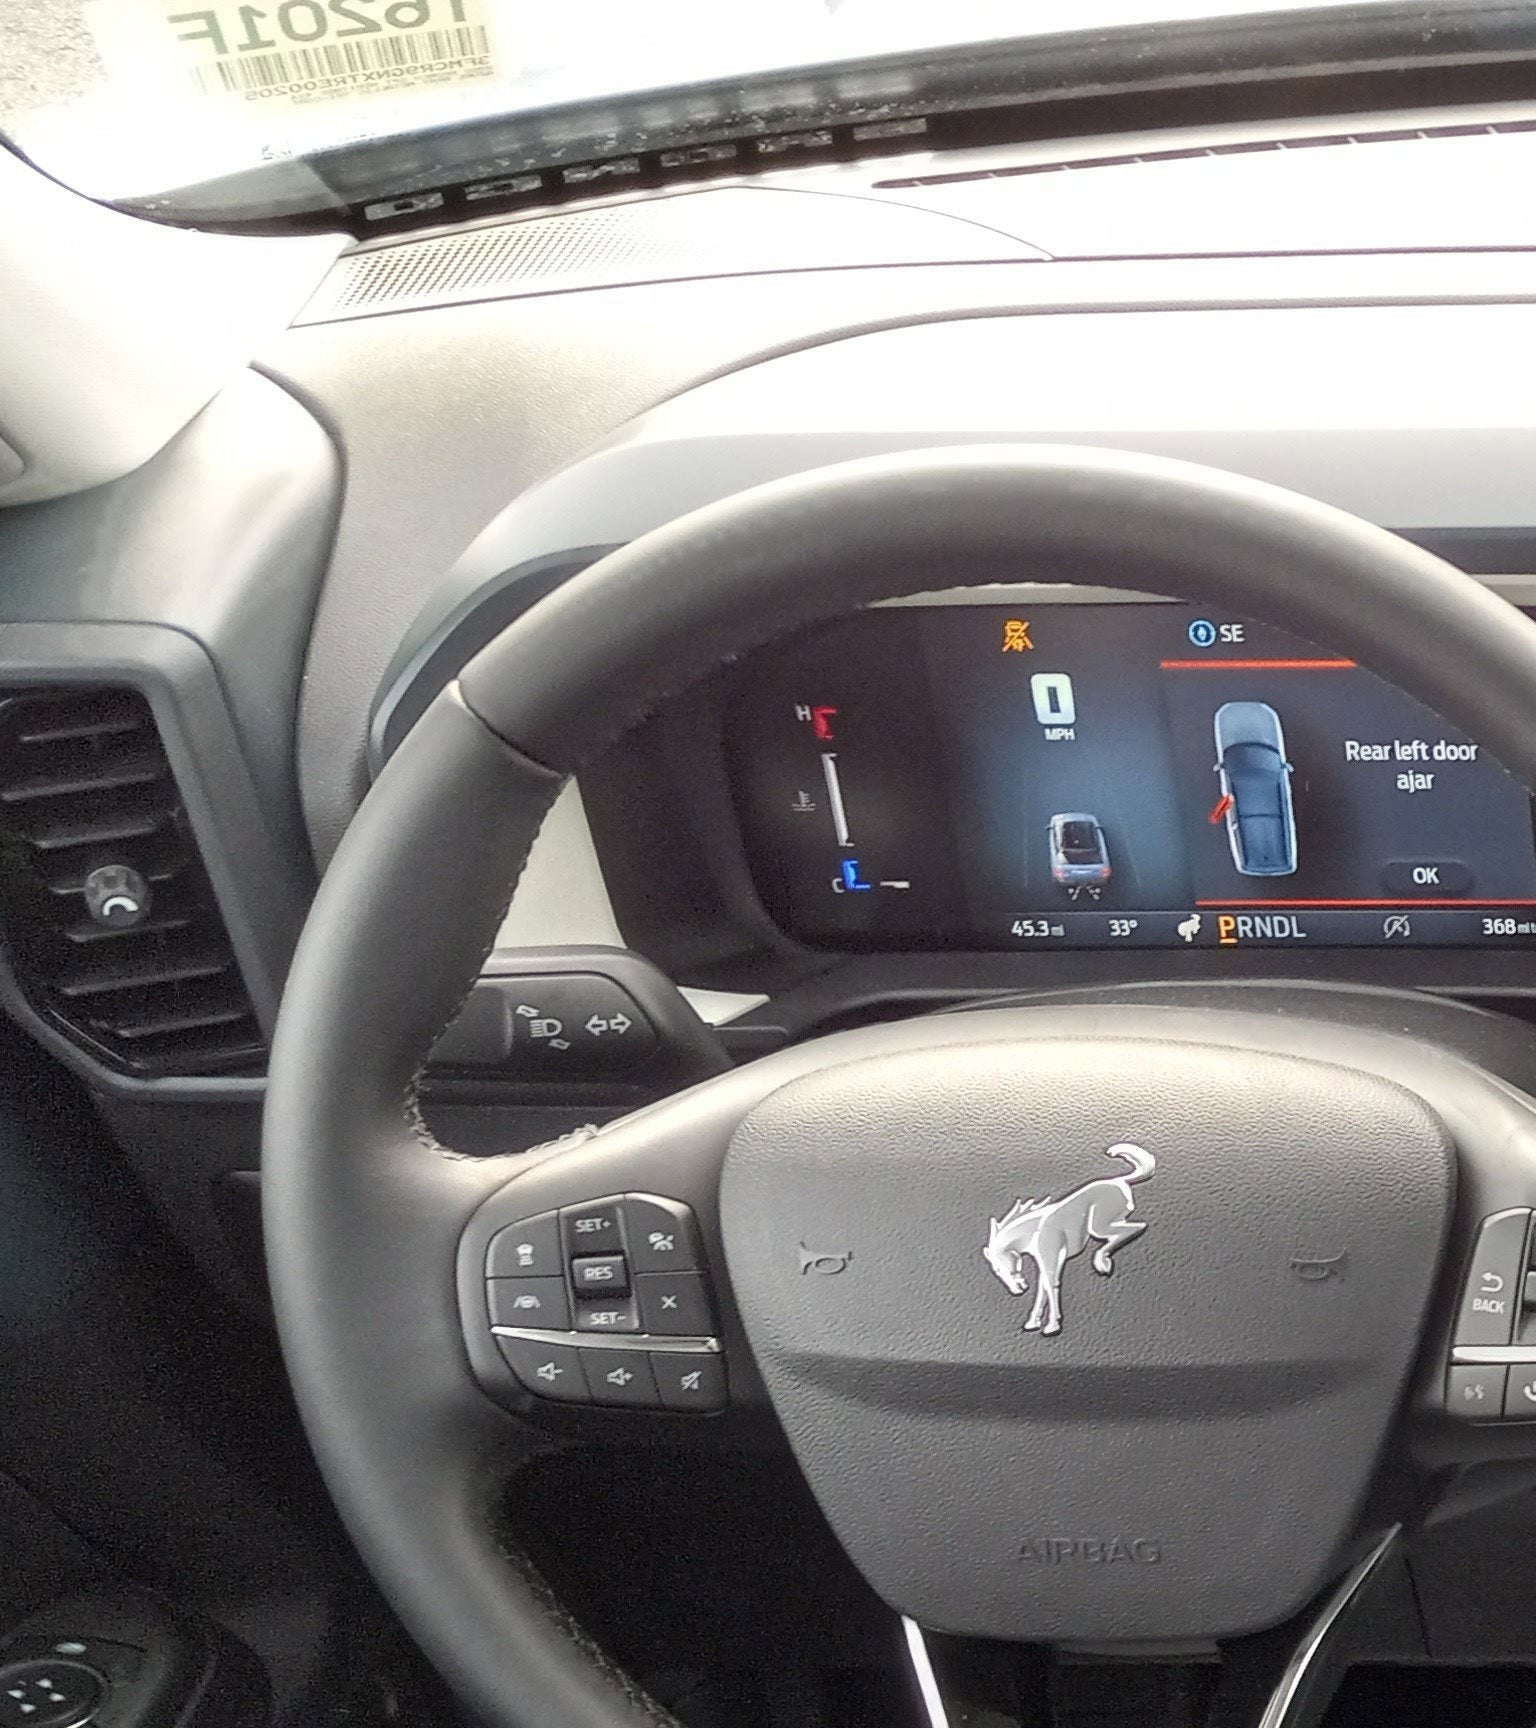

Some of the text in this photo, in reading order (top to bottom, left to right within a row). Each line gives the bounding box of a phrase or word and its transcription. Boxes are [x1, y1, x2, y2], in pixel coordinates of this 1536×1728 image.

[1220, 624, 1245, 643] SE
[1030, 672, 1076, 725] 0
[1044, 728, 1076, 742] MPH
[1344, 739, 1479, 761] Rear left door
[1396, 769, 1436, 793] ajar
[1413, 866, 1440, 885] OK
[1011, 919, 1049, 937] 45.3
[1482, 918, 1517, 935] 368
[583, 1265, 614, 1281] RES
[1472, 1298, 1506, 1315] BACK
[1017, 1537, 1162, 1565] AIRBAG
